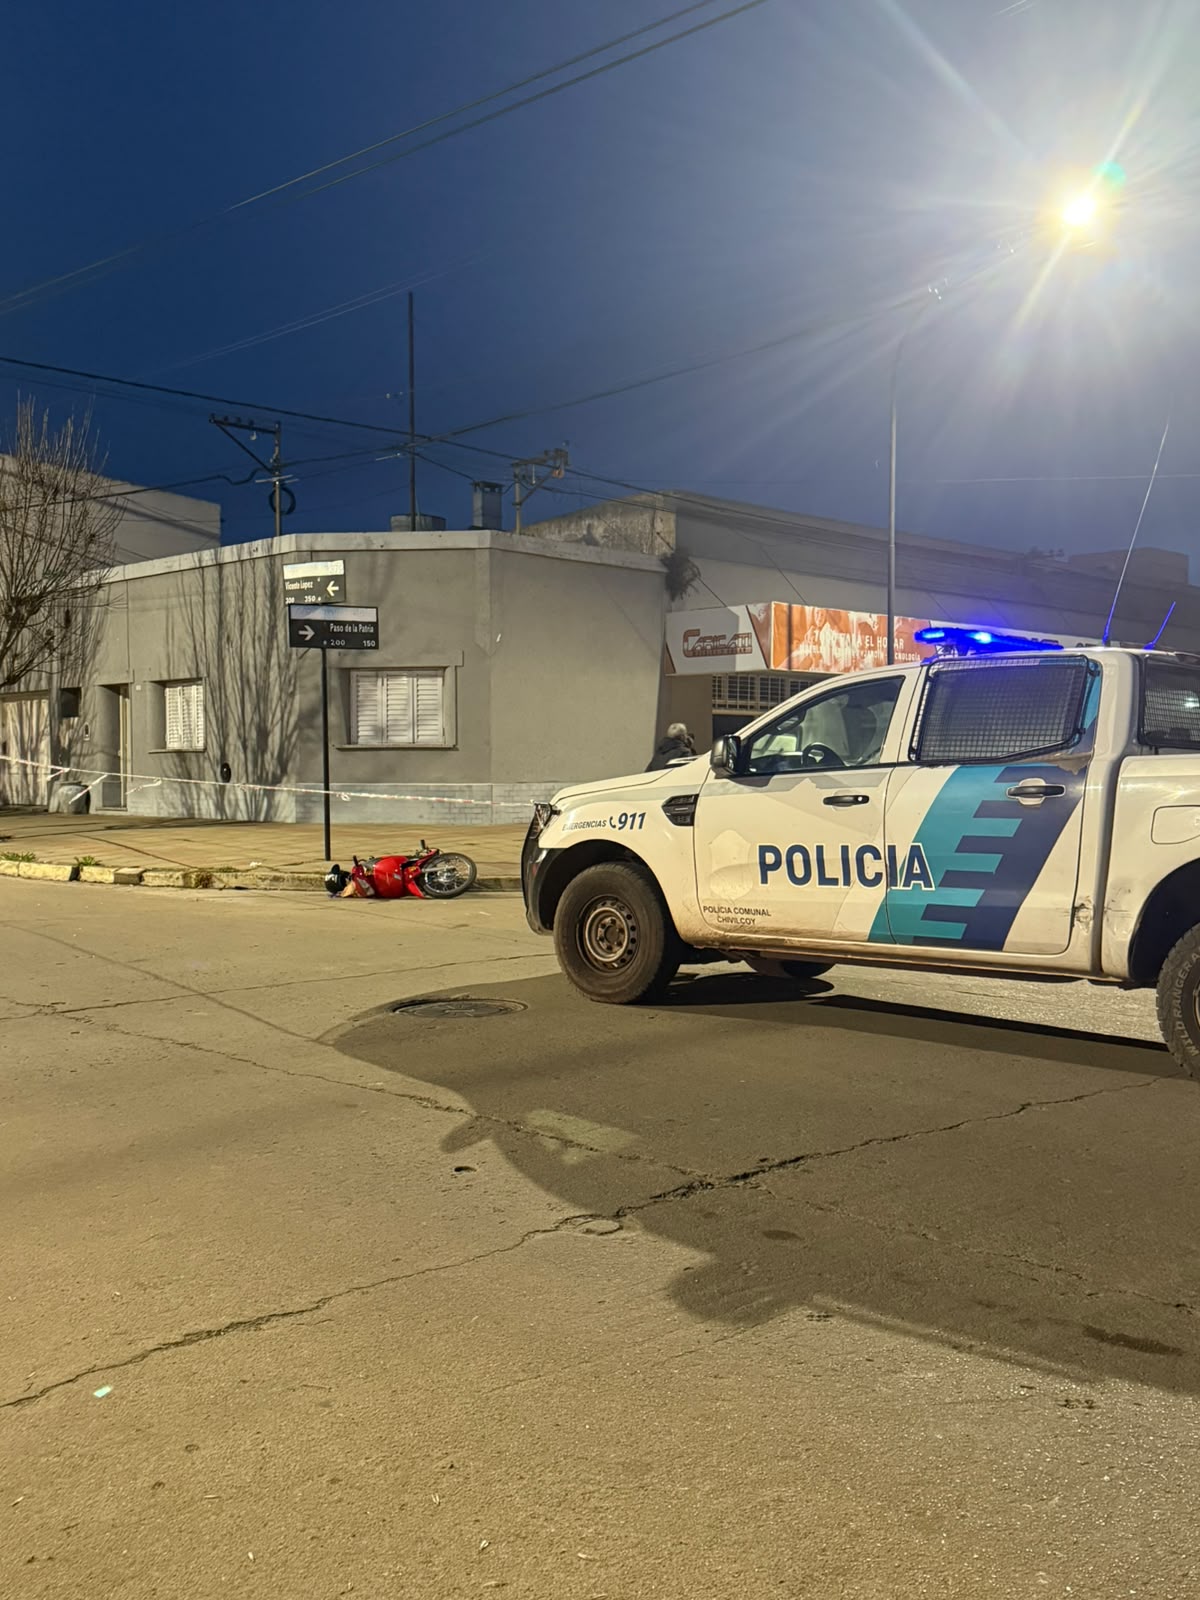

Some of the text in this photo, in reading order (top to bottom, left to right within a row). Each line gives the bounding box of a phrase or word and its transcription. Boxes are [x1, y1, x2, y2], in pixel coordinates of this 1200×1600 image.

[285, 580, 300, 590] Vicente
[330, 623, 374, 633] Paso de la Patria
[865, 635, 874, 647] EL
[877, 636, 905, 650] HOAR
[562, 812, 647, 831] EERGENCIAS 911
[758, 843, 935, 890] POLICIA
[733, 907, 772, 917] COMUNAL
[717, 915, 756, 926] CHIVILCOY
[1173, 961, 1193, 1019] RANGER
